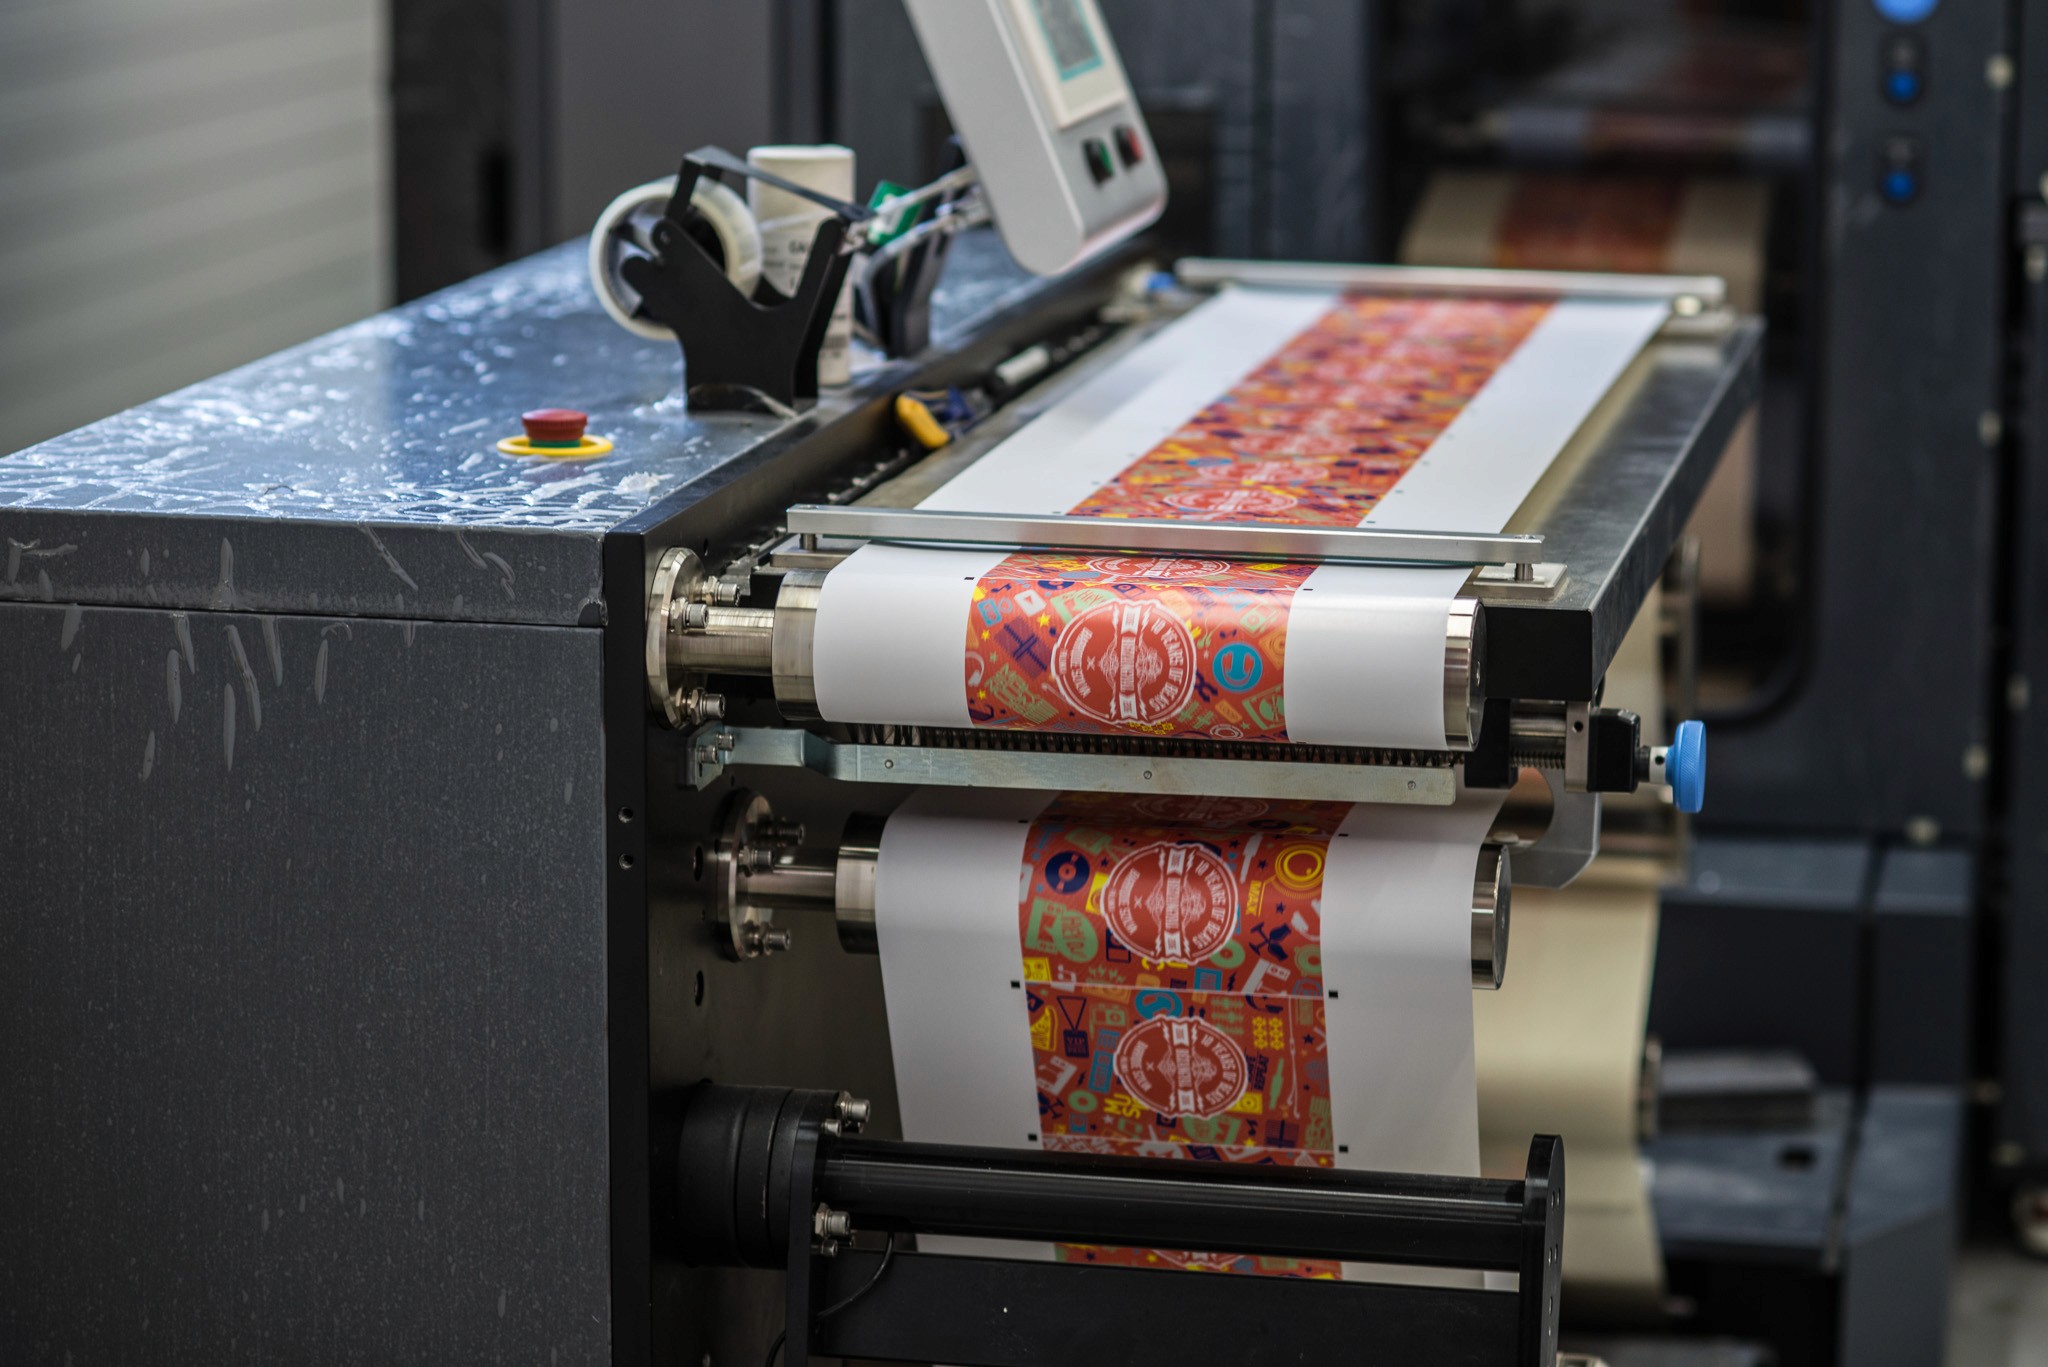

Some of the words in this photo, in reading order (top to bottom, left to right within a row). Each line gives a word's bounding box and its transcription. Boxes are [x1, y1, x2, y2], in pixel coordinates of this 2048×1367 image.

[1161, 629, 1184, 669] YEARS
[1169, 667, 1184, 685] OF
[1149, 682, 1179, 712] BEATS
[1204, 870, 1226, 905] YEARS
[1211, 905, 1226, 923] OF
[1192, 921, 1221, 950] BEATS
[1211, 1041, 1236, 1070] YEARS
[1205, 1081, 1234, 1105] BEATS
